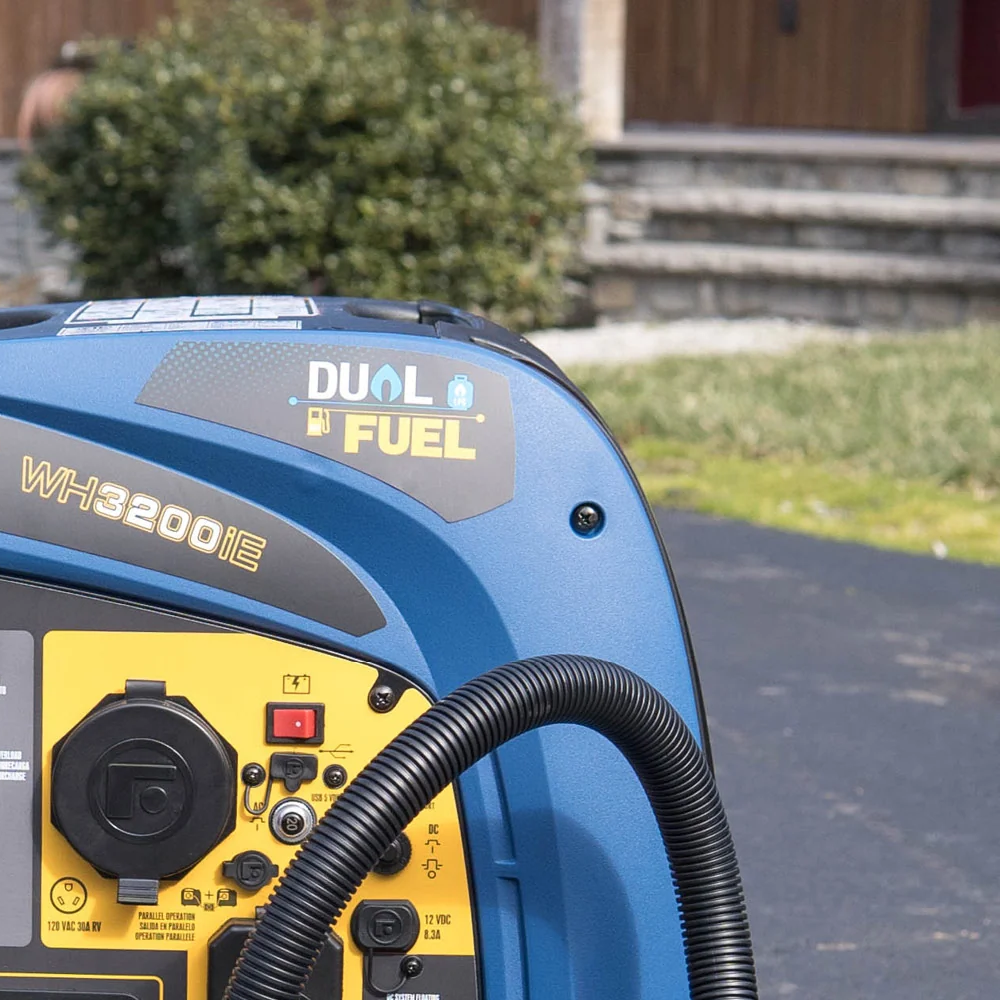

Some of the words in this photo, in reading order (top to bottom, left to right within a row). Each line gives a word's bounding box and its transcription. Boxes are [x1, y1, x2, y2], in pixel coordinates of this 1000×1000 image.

[307, 361, 433, 405] DUAL
[343, 414, 476, 460] FUEL
[428, 824, 439, 834] DC
[138, 911, 164, 920] PARALLEL
[166, 911, 195, 920] OPERATION
[425, 915, 433, 925] 12
[436, 915, 451, 925] VDC
[48, 921, 59, 931] 120
[62, 921, 75, 931] VAC
[78, 922, 90, 932] 30A
[92, 922, 101, 932] RV
[139, 922, 158, 931] SALIDA
[160, 922, 167, 931] EN
[168, 922, 195, 931] PARALELO
[424, 930, 440, 939] 8.3A
